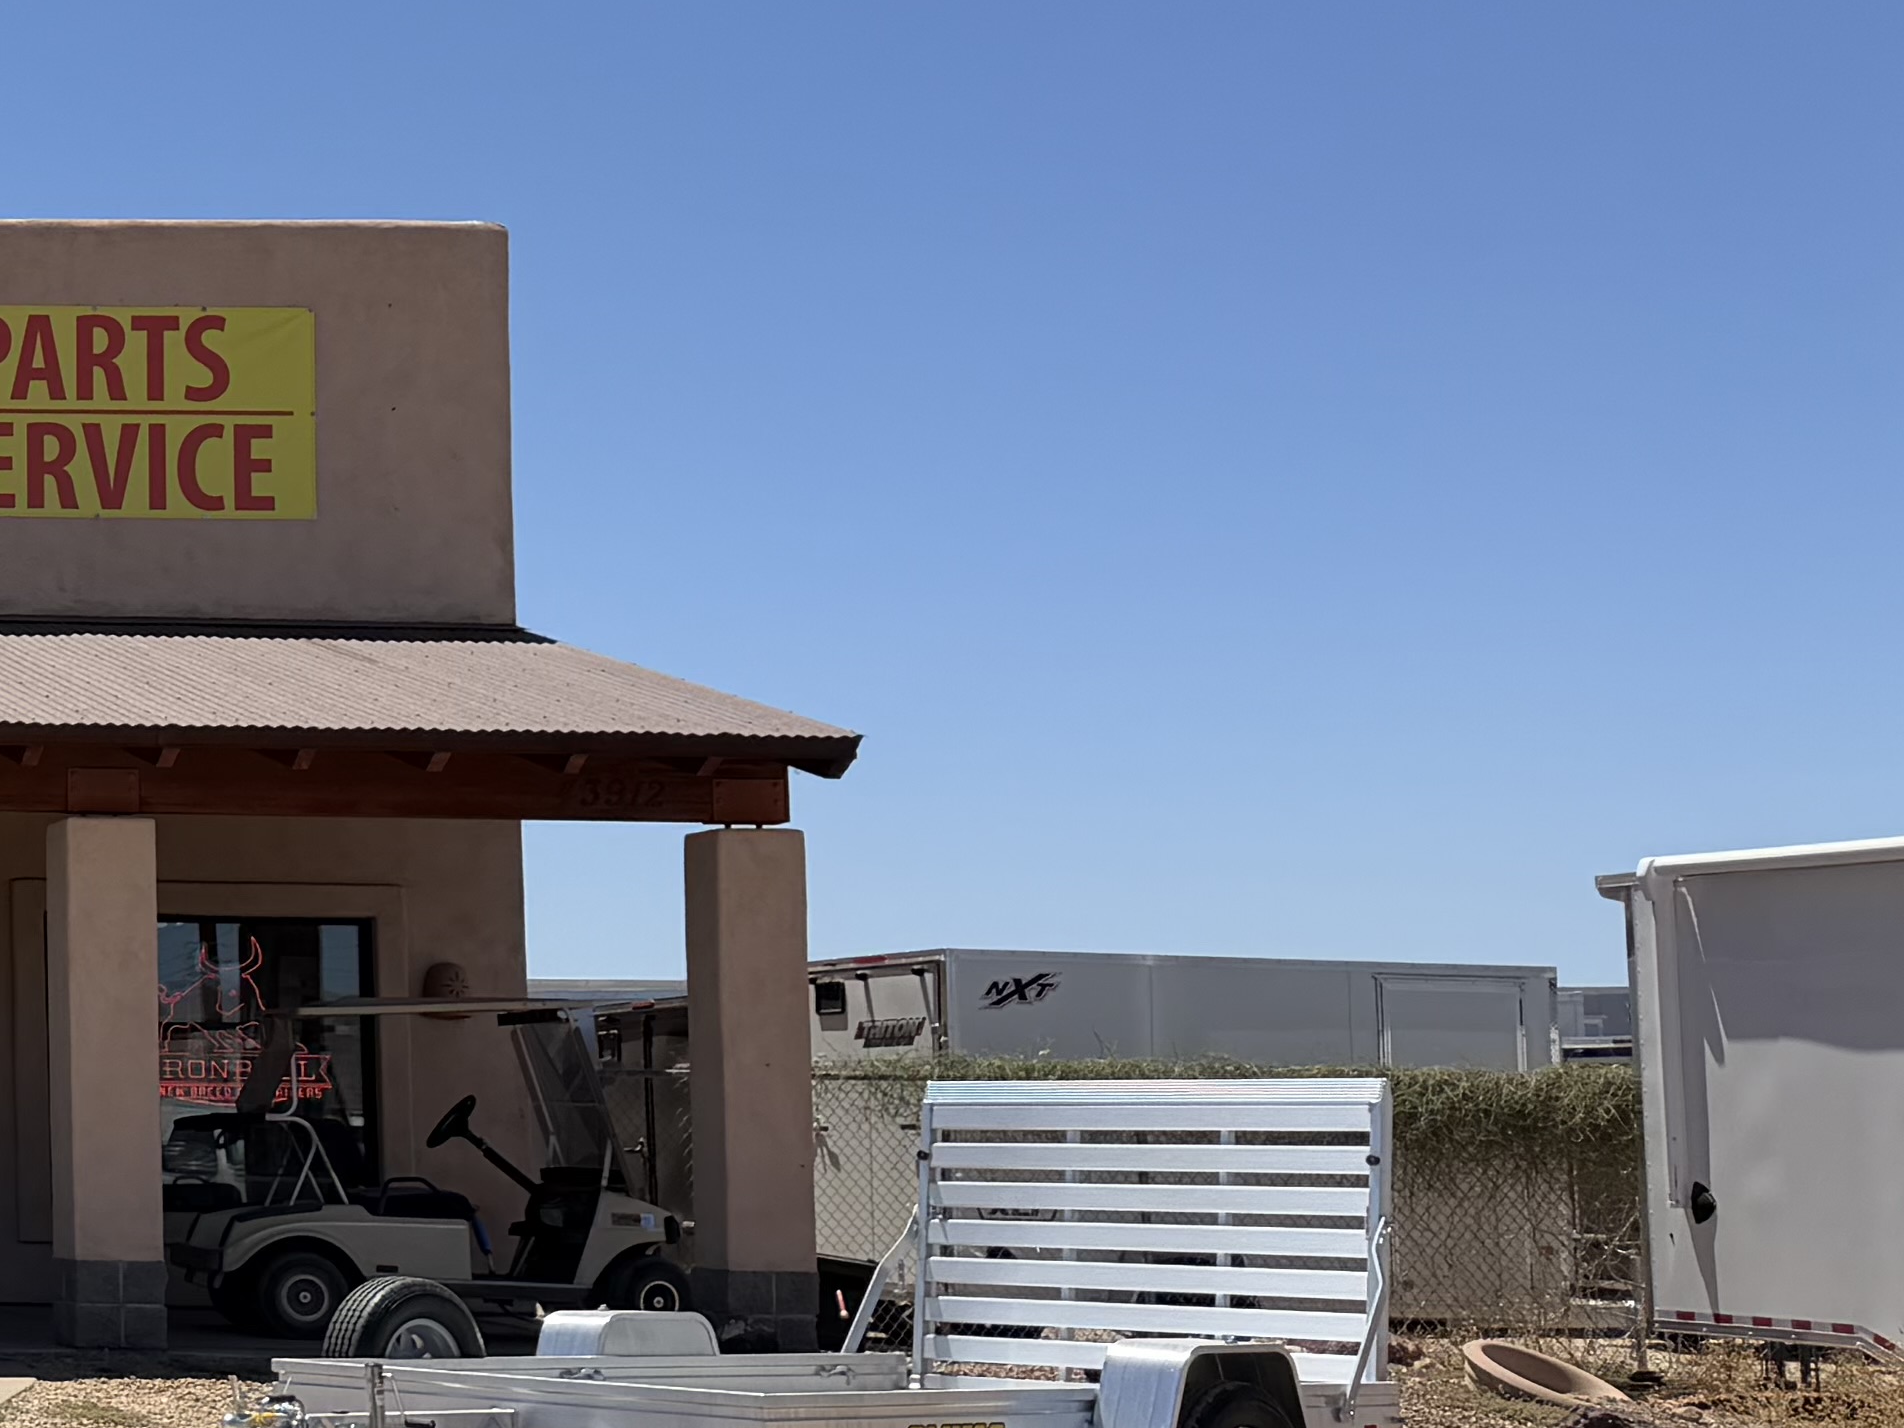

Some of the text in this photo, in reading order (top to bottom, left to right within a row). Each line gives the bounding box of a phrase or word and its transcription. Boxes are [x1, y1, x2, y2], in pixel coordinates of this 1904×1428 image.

[977, 972, 1060, 1010] NXT
[861, 1019, 920, 1039] TRITON
[161, 1058, 315, 1081] RONBL
